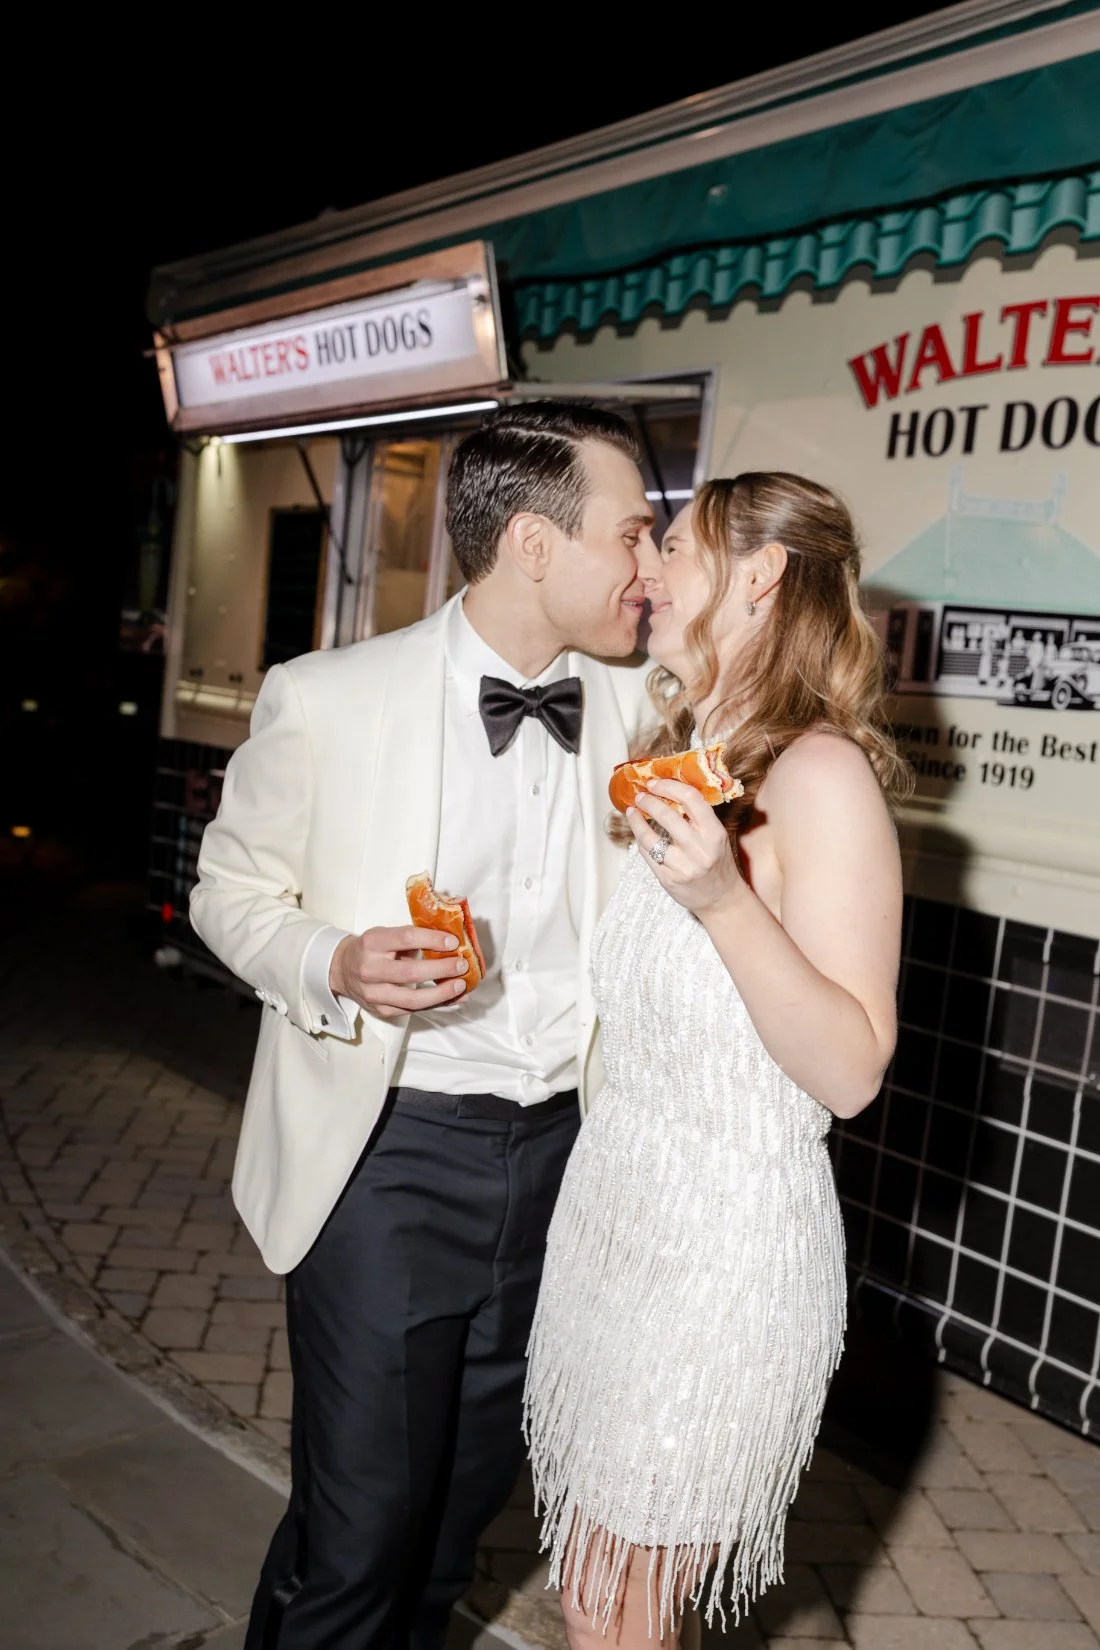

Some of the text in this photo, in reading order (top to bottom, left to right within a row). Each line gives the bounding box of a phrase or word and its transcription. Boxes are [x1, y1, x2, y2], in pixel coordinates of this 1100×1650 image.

[208, 308, 433, 385] WALTER'S HOT DOGS
[847, 295, 1100, 410] WALTE
[886, 403, 989, 460] HOT
[906, 750, 1035, 790] Since 1919
[948, 723, 982, 749] for
[993, 729, 1030, 755] the
[1040, 733, 1098, 763] Best
